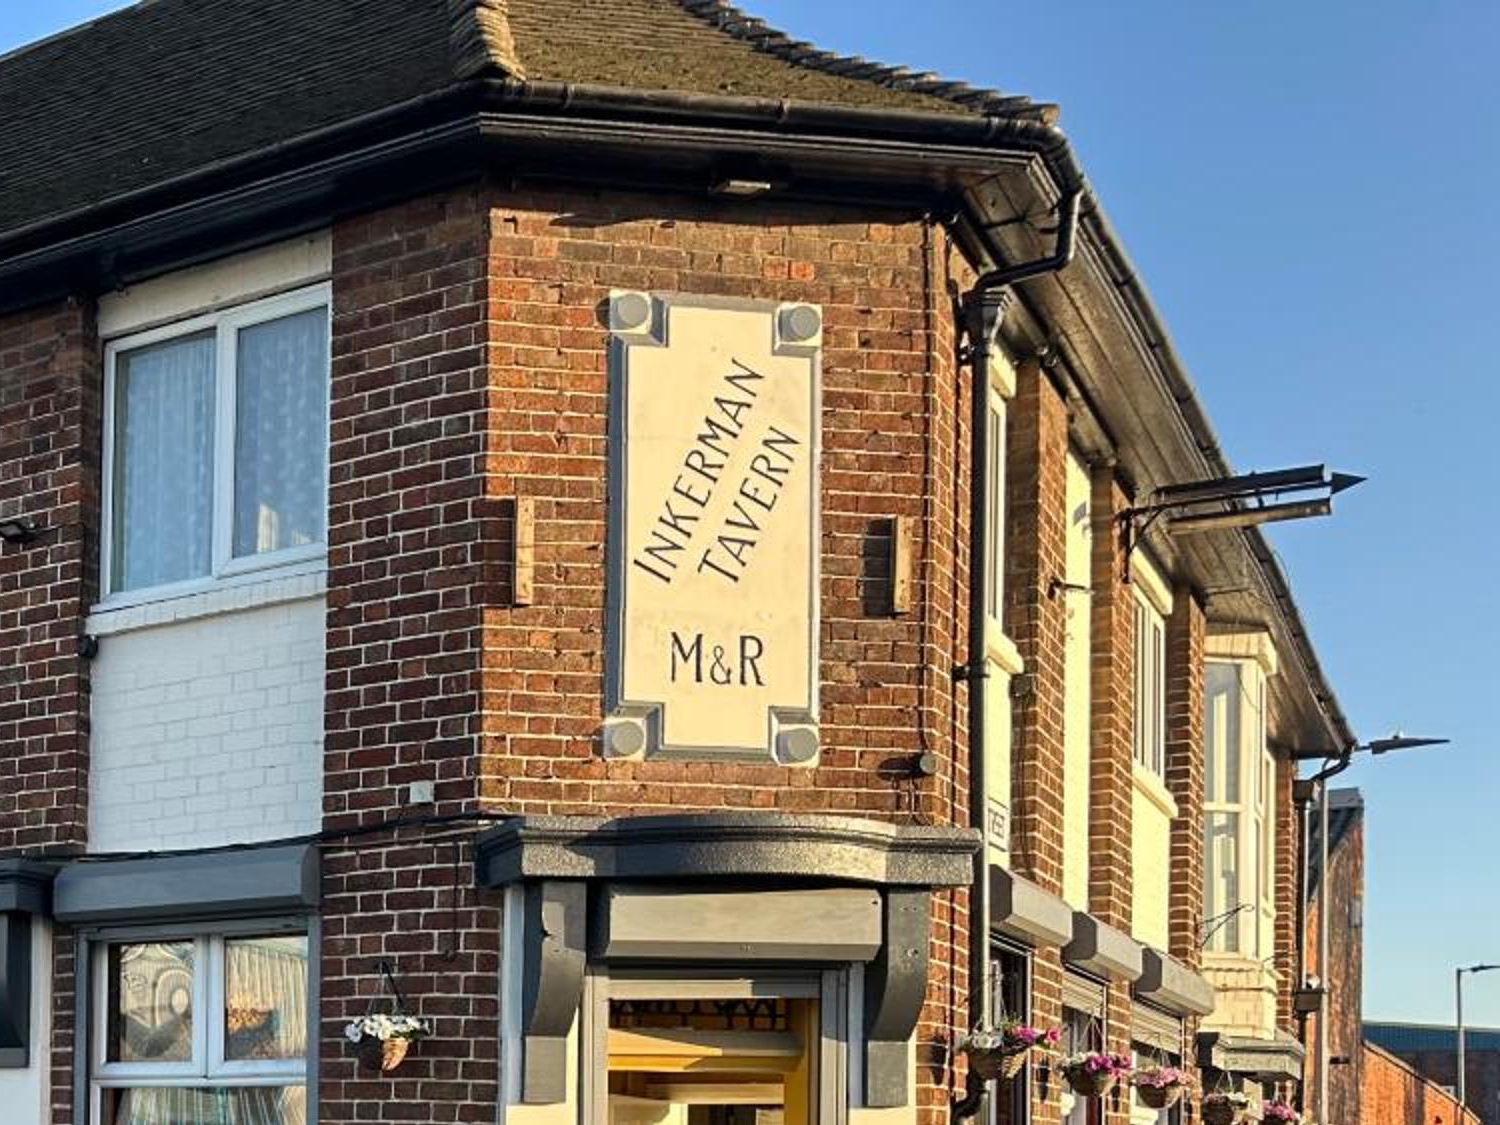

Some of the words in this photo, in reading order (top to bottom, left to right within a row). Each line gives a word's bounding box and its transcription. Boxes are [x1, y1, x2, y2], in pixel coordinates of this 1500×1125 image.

[633, 357, 766, 584] INKERMAN
[697, 425, 802, 583] TAVERN
[669, 630, 767, 687] M&R
